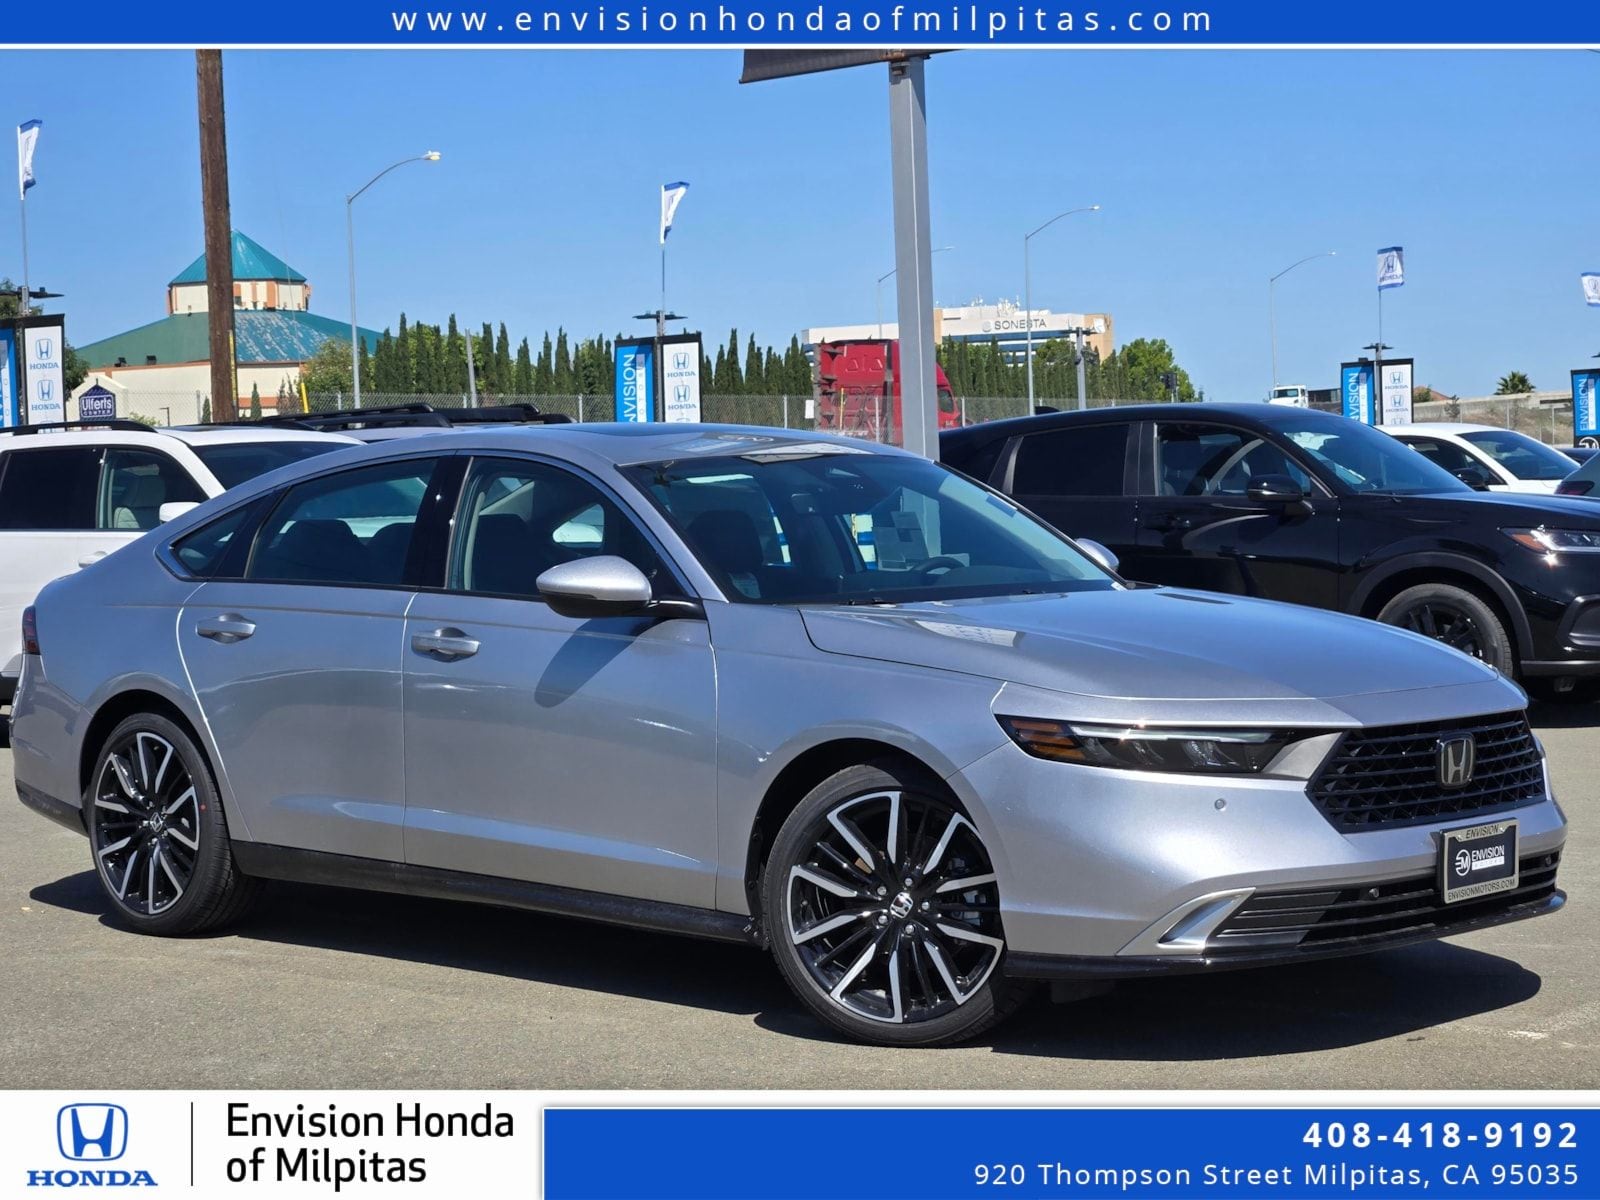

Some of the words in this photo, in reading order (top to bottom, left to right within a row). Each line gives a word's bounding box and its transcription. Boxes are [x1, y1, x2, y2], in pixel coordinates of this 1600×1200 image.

[994, 319, 1047, 331] SONESTA
[30, 362, 59, 370] HONDA
[623, 354, 637, 421] NVISION
[31, 403, 61, 411] HONDA
[82, 398, 112, 411] Ulferts
[1578, 378, 1588, 431] ENVISION
[1466, 824, 1499, 839] ENVISION
[1472, 845, 1504, 862] ENVISION
[1447, 879, 1515, 900] ENVISIONMOTORS.COM
